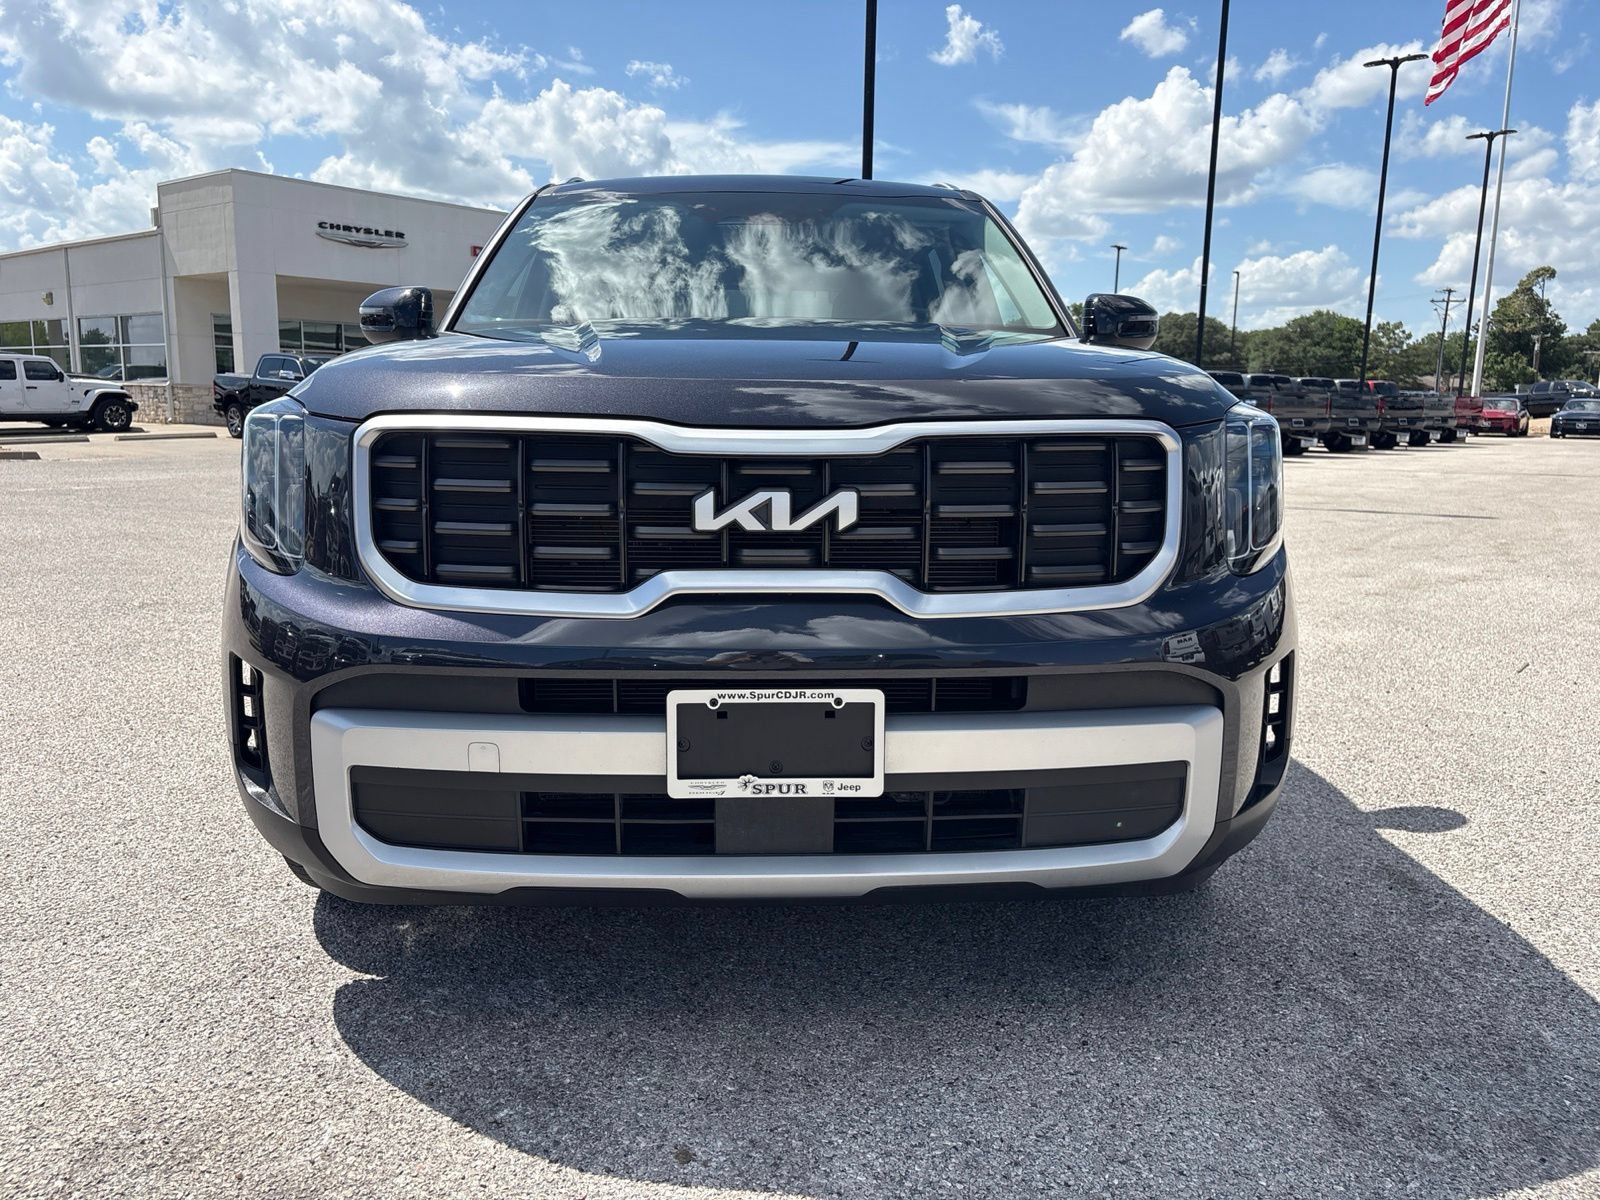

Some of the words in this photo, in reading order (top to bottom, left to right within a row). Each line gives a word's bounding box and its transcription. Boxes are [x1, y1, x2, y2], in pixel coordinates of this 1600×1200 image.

[318, 221, 406, 239] CHRYSLER
[695, 490, 857, 531] KIA
[717, 691, 835, 701] www.SpurCDJR.com
[752, 783, 808, 795] SPUR
[837, 783, 861, 792] Jeep
